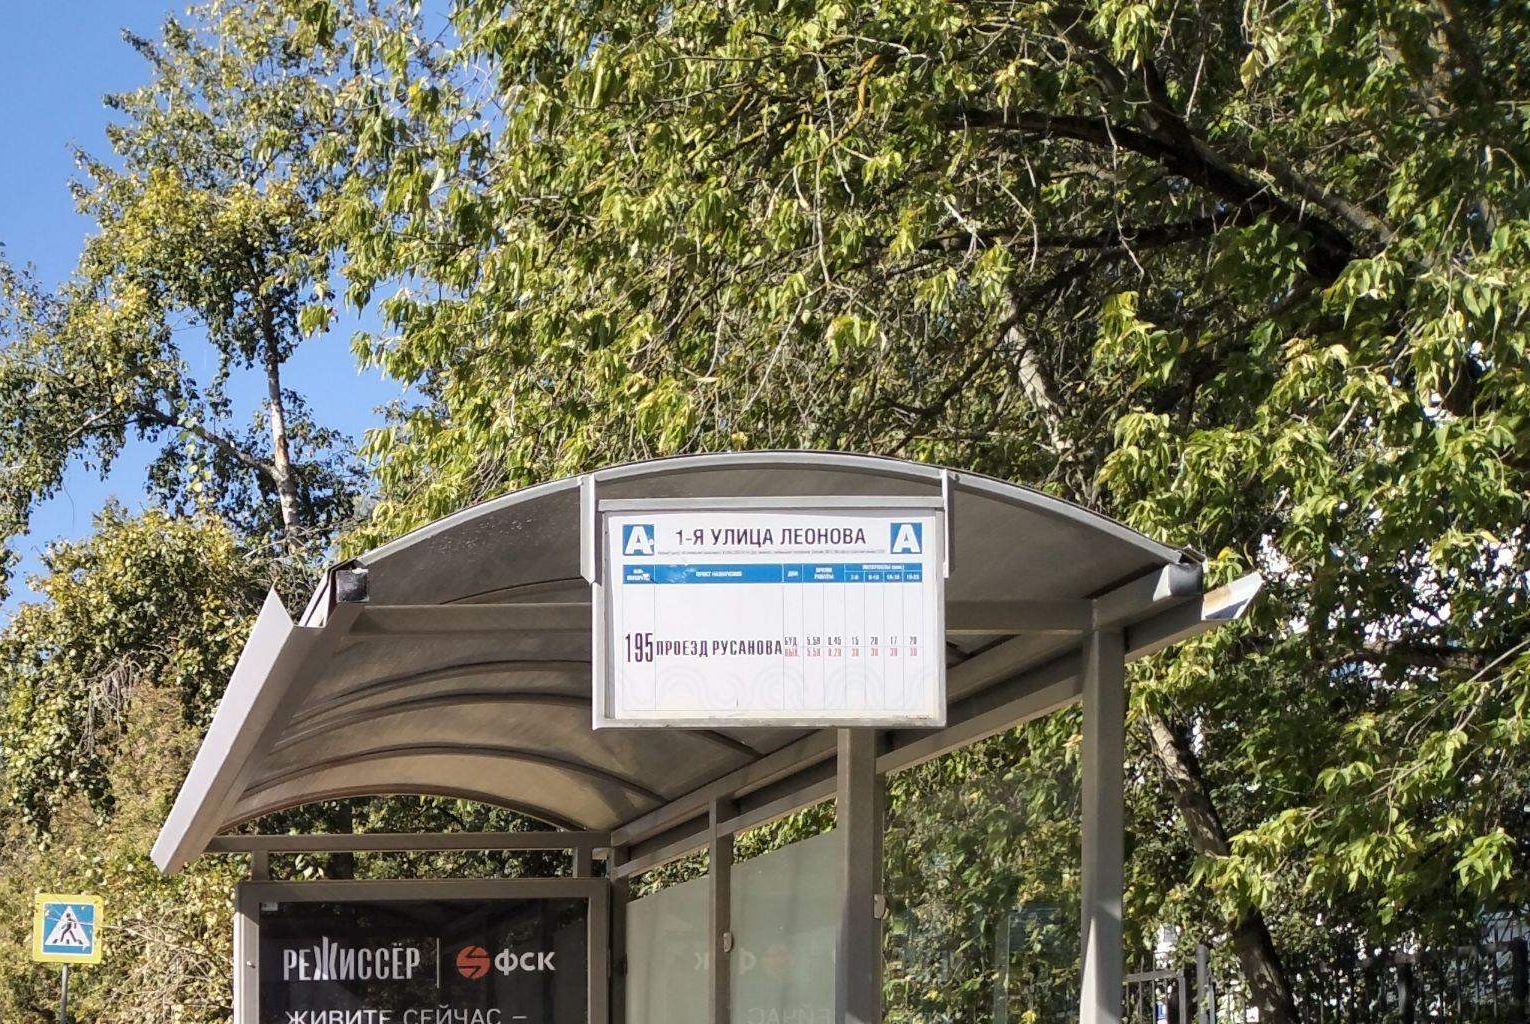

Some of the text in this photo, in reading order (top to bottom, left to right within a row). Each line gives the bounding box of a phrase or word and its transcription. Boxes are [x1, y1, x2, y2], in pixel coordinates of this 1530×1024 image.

[675, 527, 866, 548] 1-Я УЛИЦА ЛЕОНОВА
[624, 632, 783, 663] 195 ПРОЕЗД РУСАНОВА
[283, 935, 420, 981] РЕЖИССЁР
